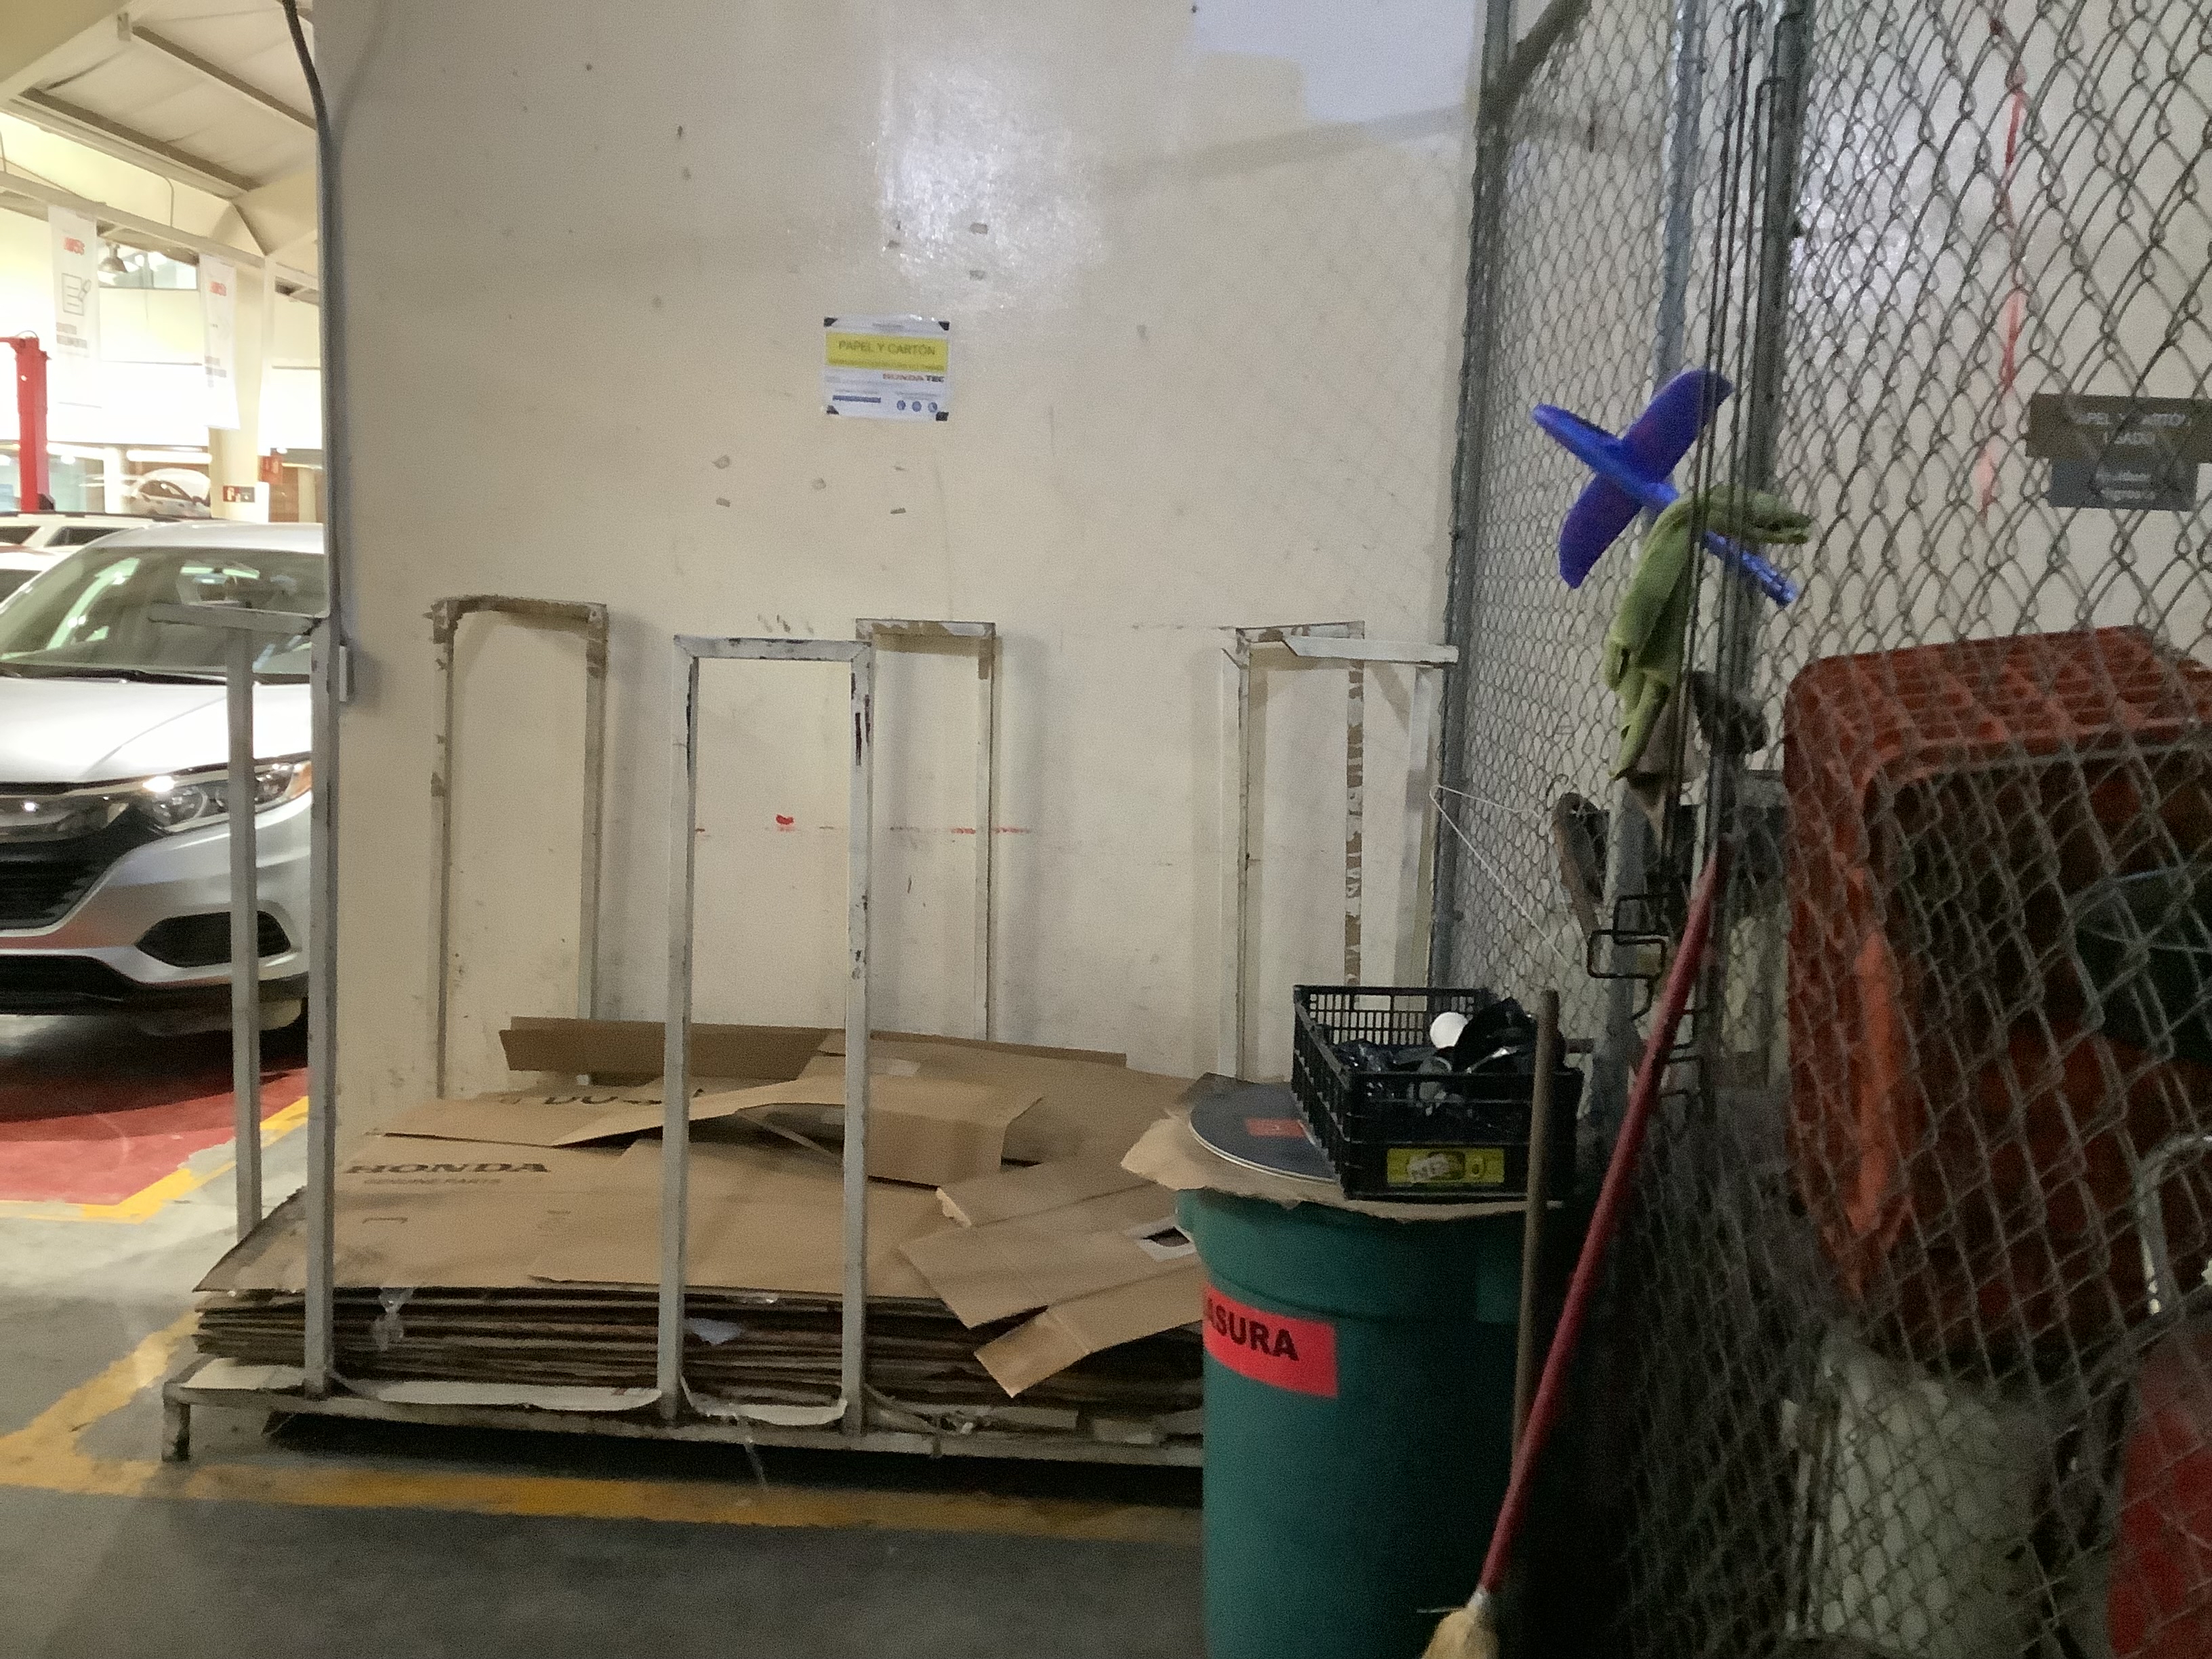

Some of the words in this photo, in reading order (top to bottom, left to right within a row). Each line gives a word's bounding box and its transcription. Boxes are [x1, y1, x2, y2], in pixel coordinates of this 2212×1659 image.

[838, 340, 873, 352] PAPEL
[877, 342, 884, 352] Y
[346, 1163, 550, 1174] HONDA
[1207, 1297, 1299, 1361] ASURA
